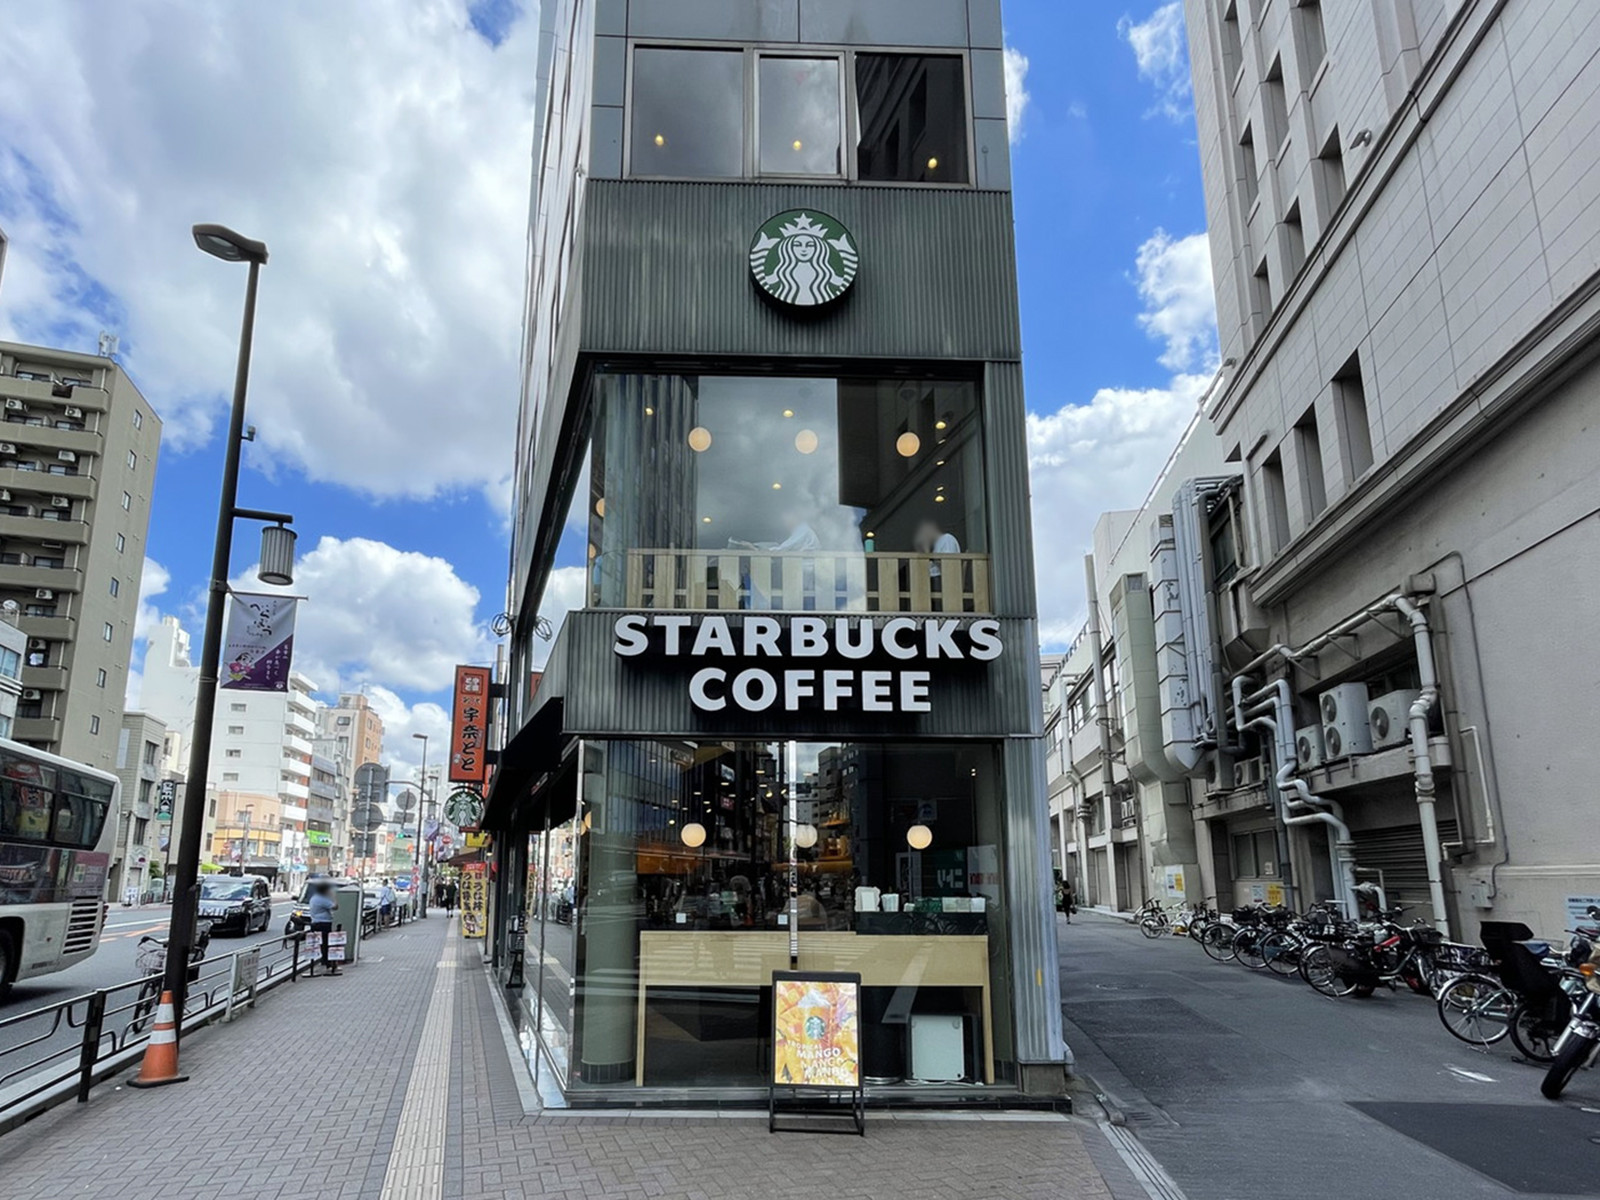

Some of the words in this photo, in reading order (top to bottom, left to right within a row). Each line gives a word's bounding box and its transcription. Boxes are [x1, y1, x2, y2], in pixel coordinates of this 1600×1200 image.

[613, 614, 1004, 661] STARBUCKS
[689, 667, 932, 712] COFFEE
[461, 706, 479, 772] 宇奈とと
[796, 1047, 841, 1059] MANGO
